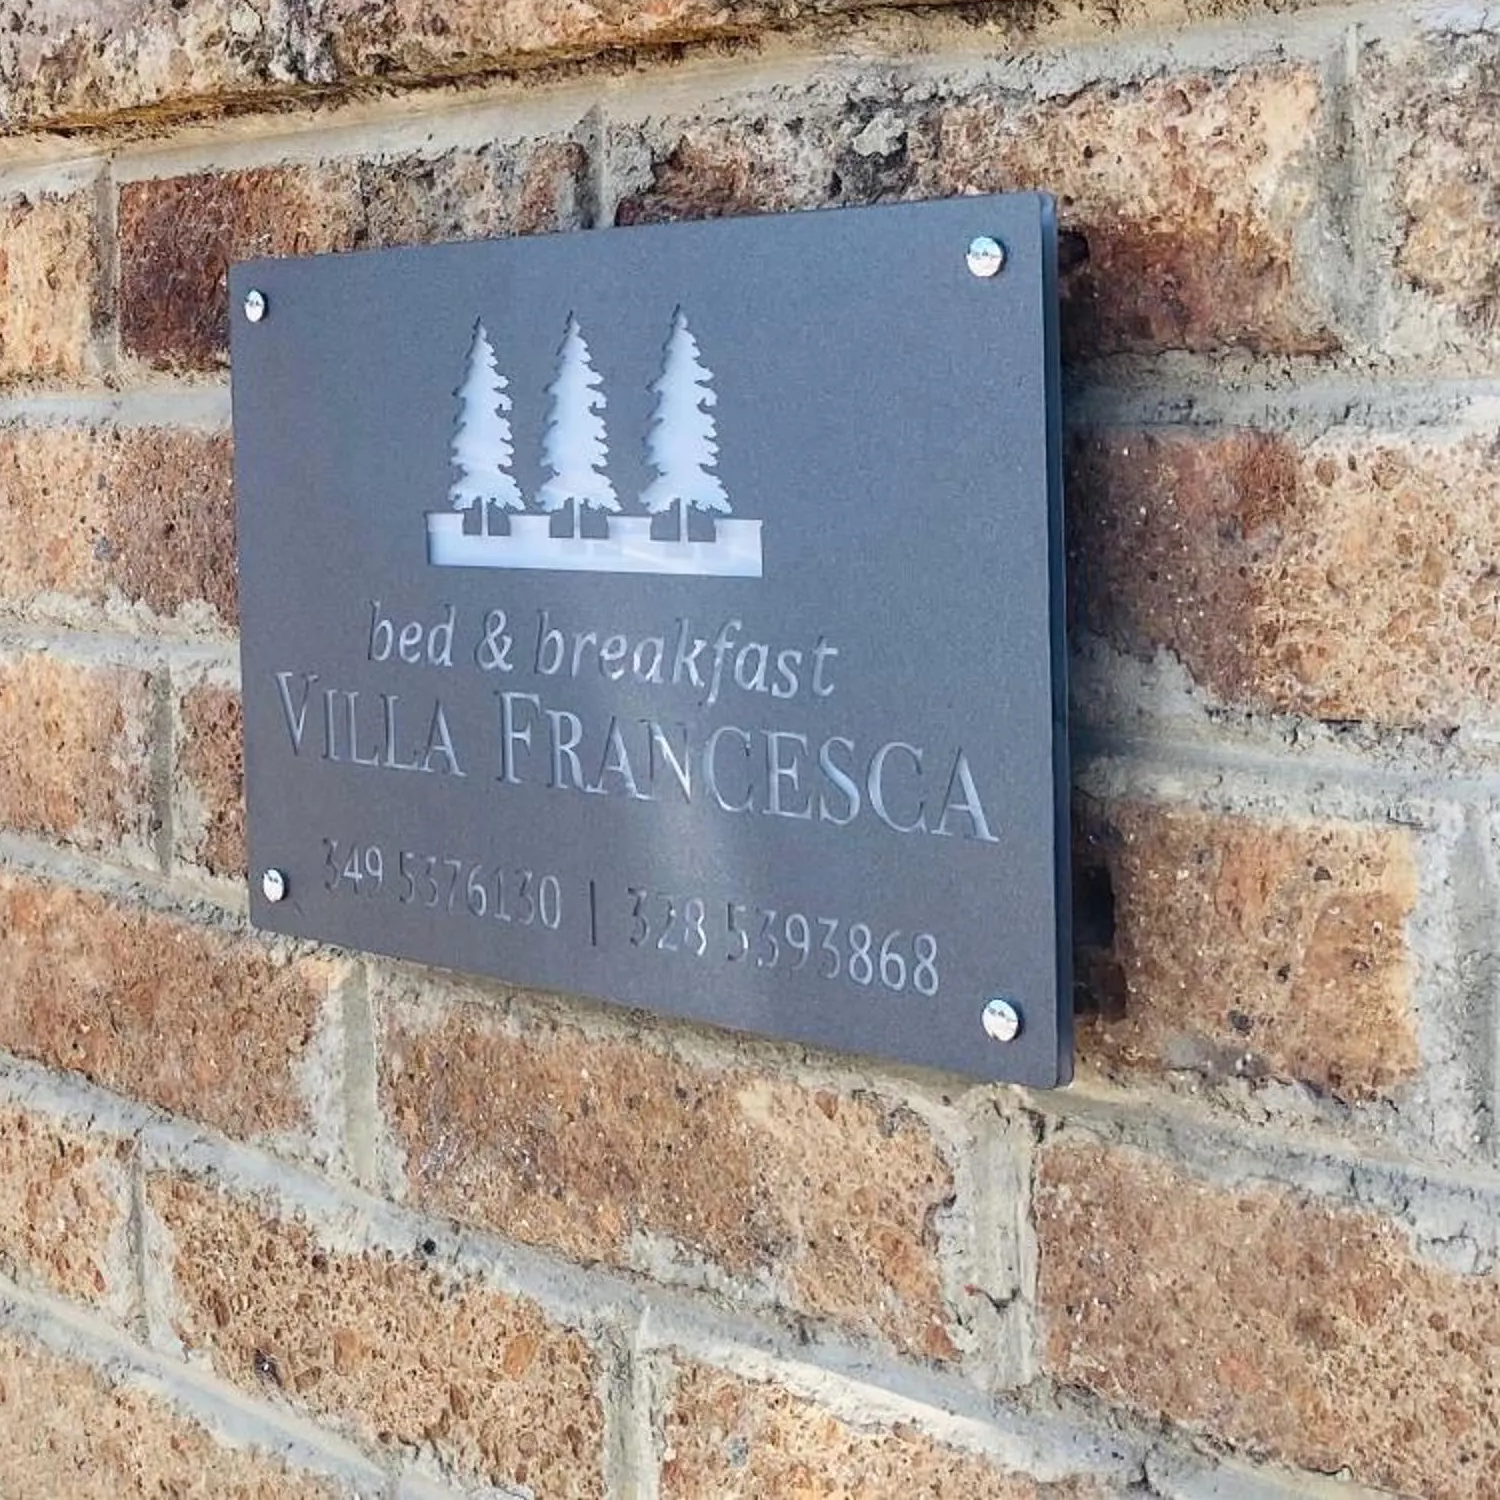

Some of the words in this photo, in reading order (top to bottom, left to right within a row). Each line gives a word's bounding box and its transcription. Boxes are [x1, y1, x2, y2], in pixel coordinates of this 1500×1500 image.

[367, 599, 457, 668] bed
[473, 607, 514, 673] &
[533, 607, 839, 706] breakfast
[275, 670, 468, 779] VILLA
[493, 689, 1000, 843] FRANCESCA
[322, 836, 384, 895] 349
[399, 850, 562, 941] 5376130
[626, 886, 708, 957] 328
[725, 901, 940, 998] 5393868
